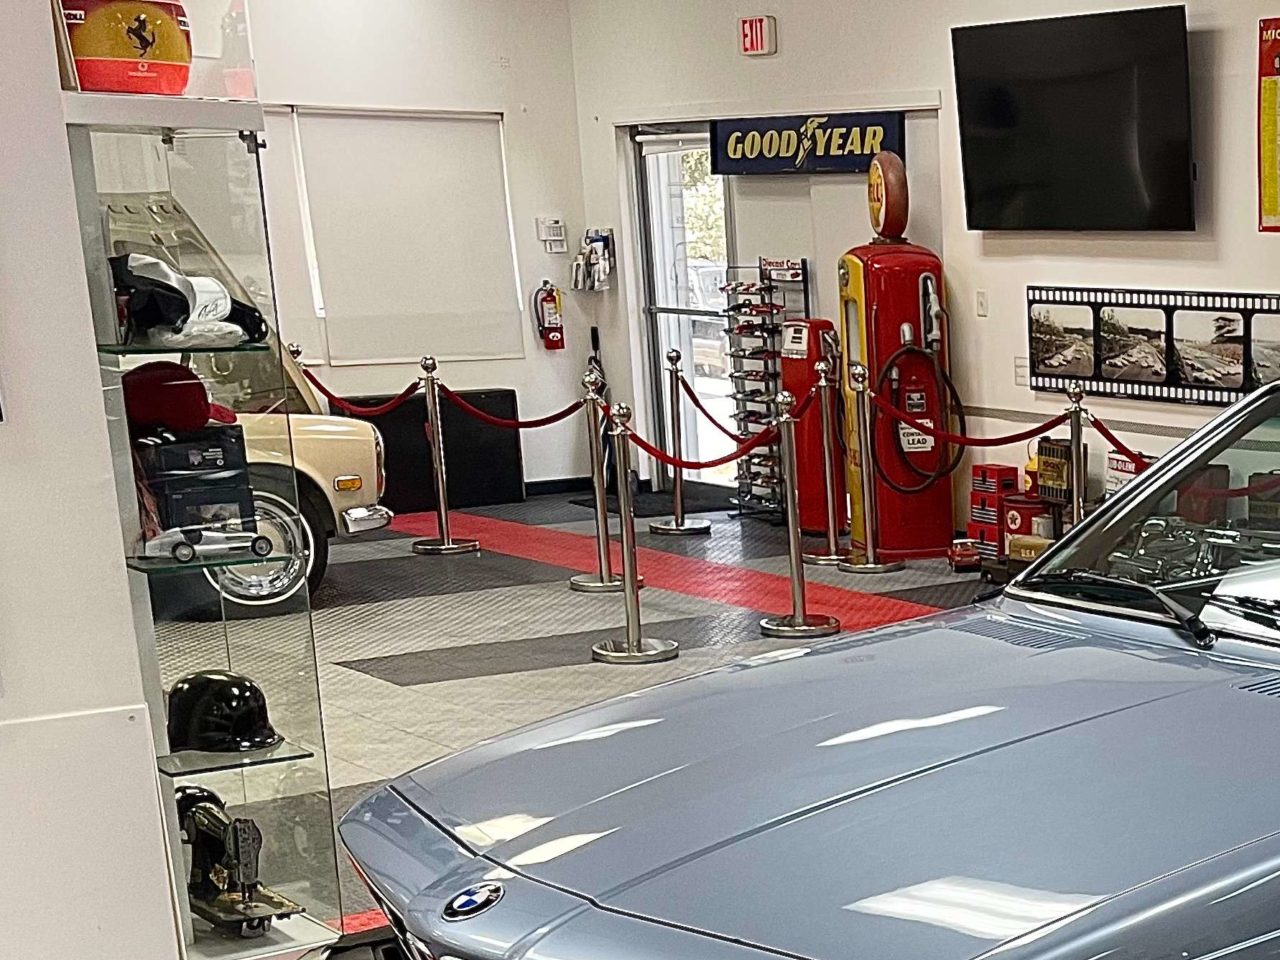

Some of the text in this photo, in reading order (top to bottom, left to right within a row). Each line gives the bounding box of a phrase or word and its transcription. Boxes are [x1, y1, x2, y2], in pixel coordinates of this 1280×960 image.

[741, 18, 764, 52] EXIT
[762, 257, 785, 268] Diecast
[907, 437, 927, 446] LEAD
